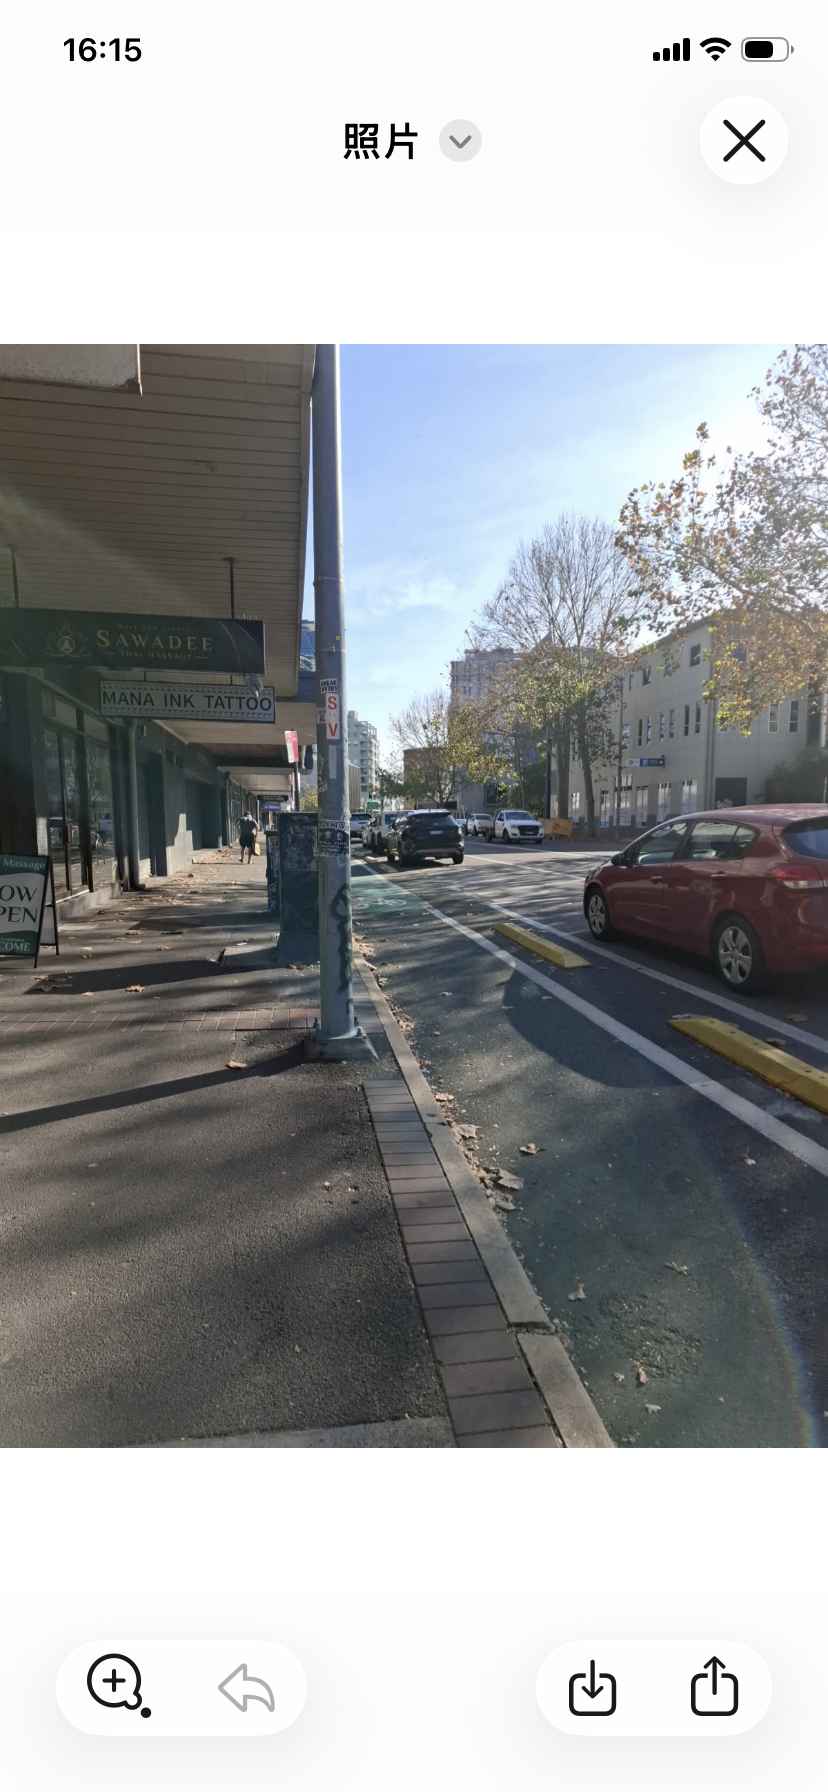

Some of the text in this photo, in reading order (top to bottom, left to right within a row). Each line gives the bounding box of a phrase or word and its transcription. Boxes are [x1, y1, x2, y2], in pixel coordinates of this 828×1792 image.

[96, 629, 213, 652] SAWADEE
[121, 650, 192, 660] THAI MASSAGE
[102, 690, 272, 712] MANA INK TATTOO
[3, 858, 46, 871] Massage
